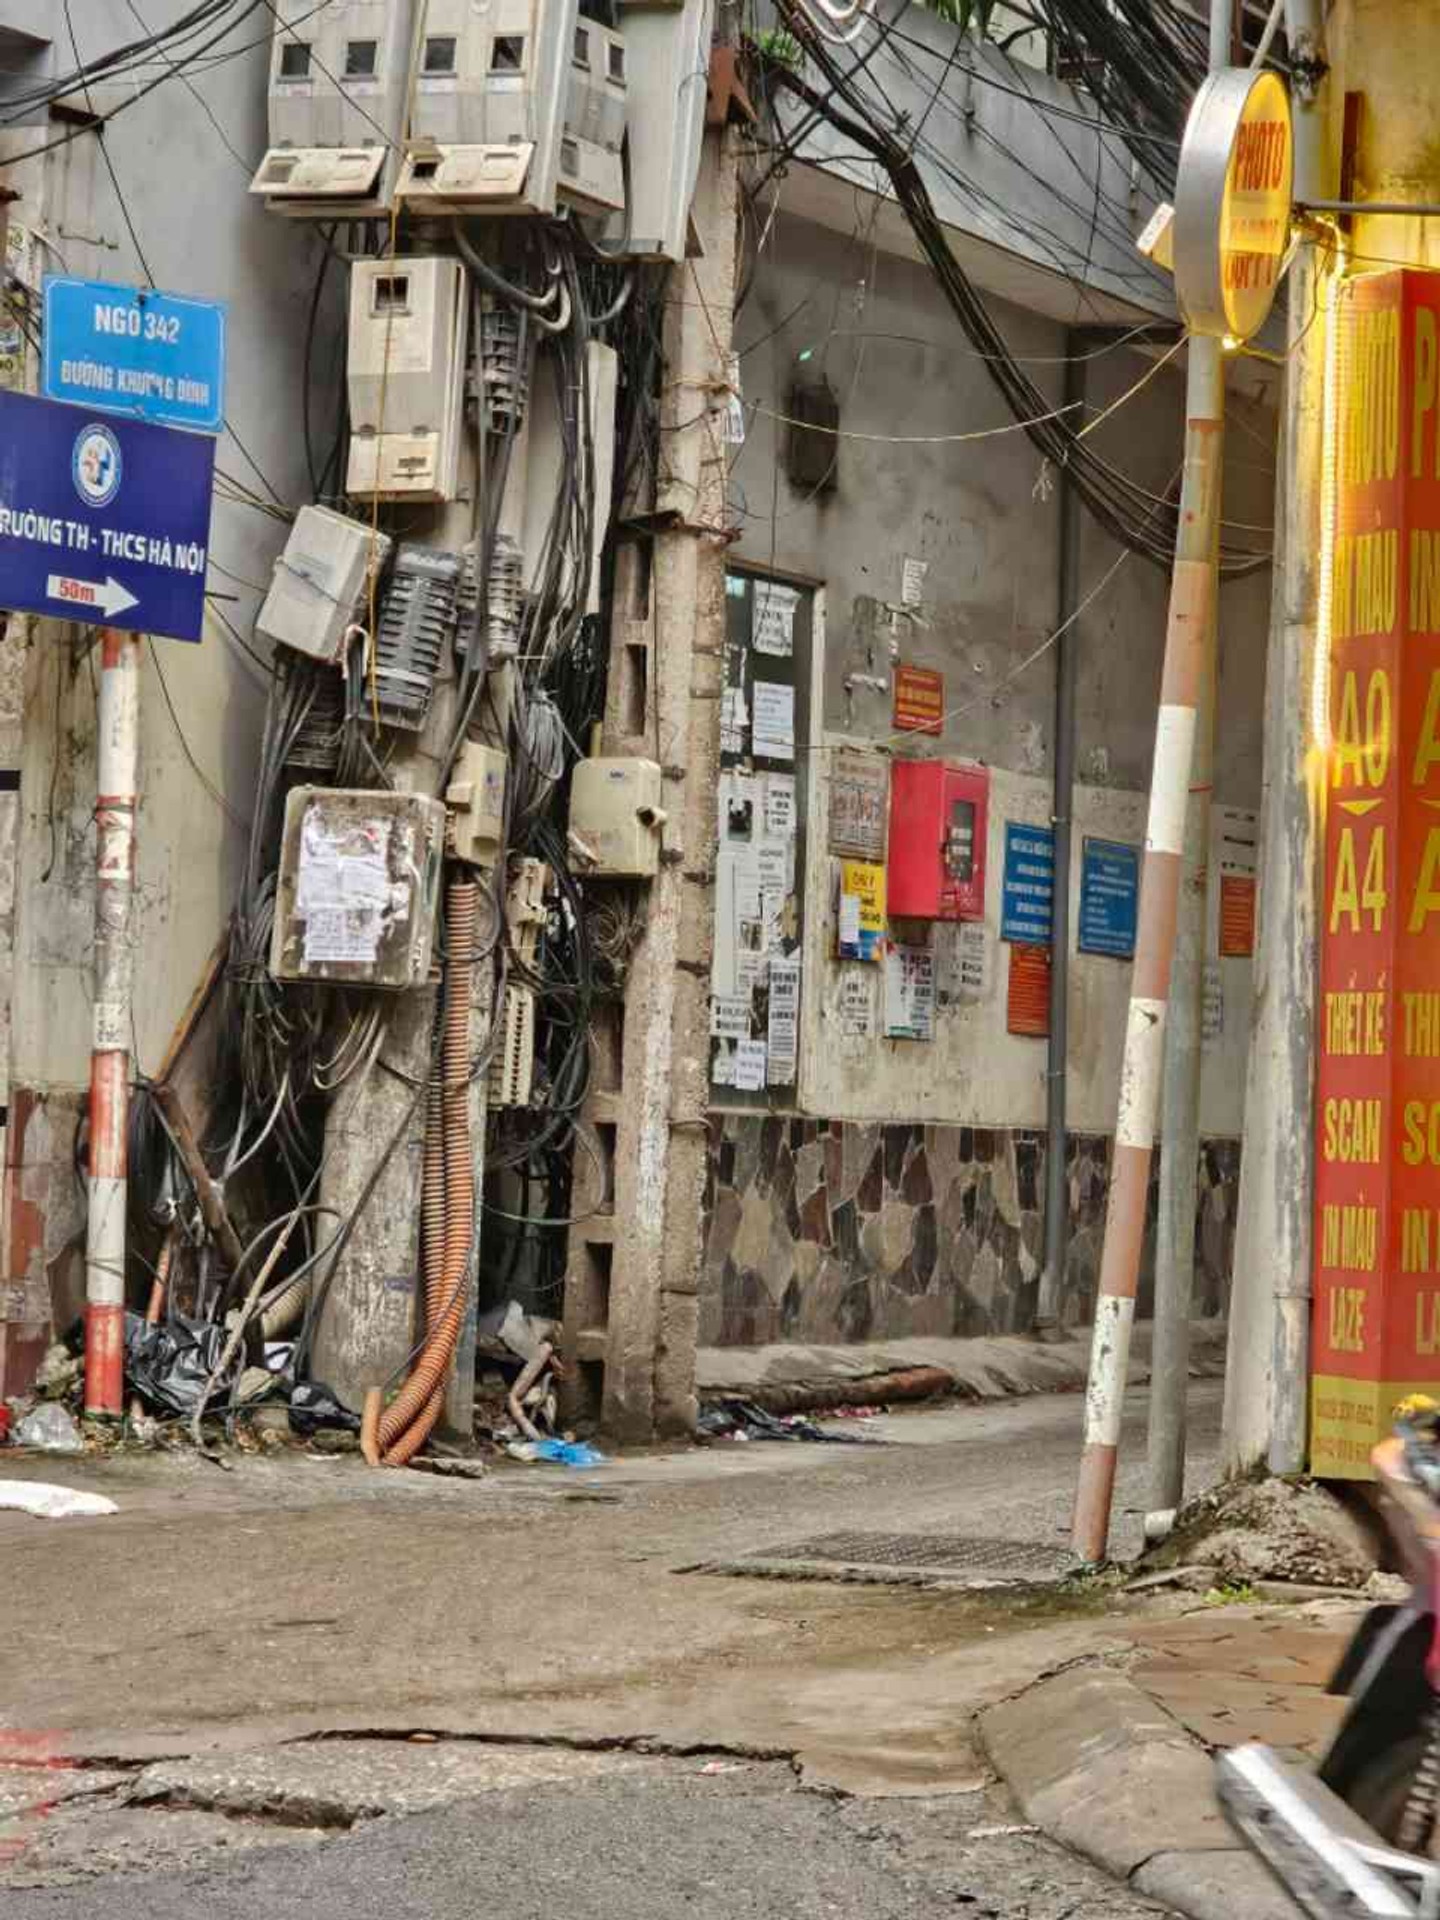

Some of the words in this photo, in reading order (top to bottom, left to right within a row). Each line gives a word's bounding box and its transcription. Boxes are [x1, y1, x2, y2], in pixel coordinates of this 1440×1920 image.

[1234, 121, 1286, 192] PHOTO
[144, 312, 180, 344] 342
[67, 522, 89, 550] TH
[101, 528, 147, 562] THCS
[150, 536, 172, 568] HÀ
[175, 541, 205, 575] NỘI
[59, 579, 95, 602] 50m
[1329, 826, 1387, 935] A4
[1324, 1098, 1381, 1164] SCAN
[1322, 1205, 1340, 1268] IN
[1329, 1287, 1368, 1351] LAZE
